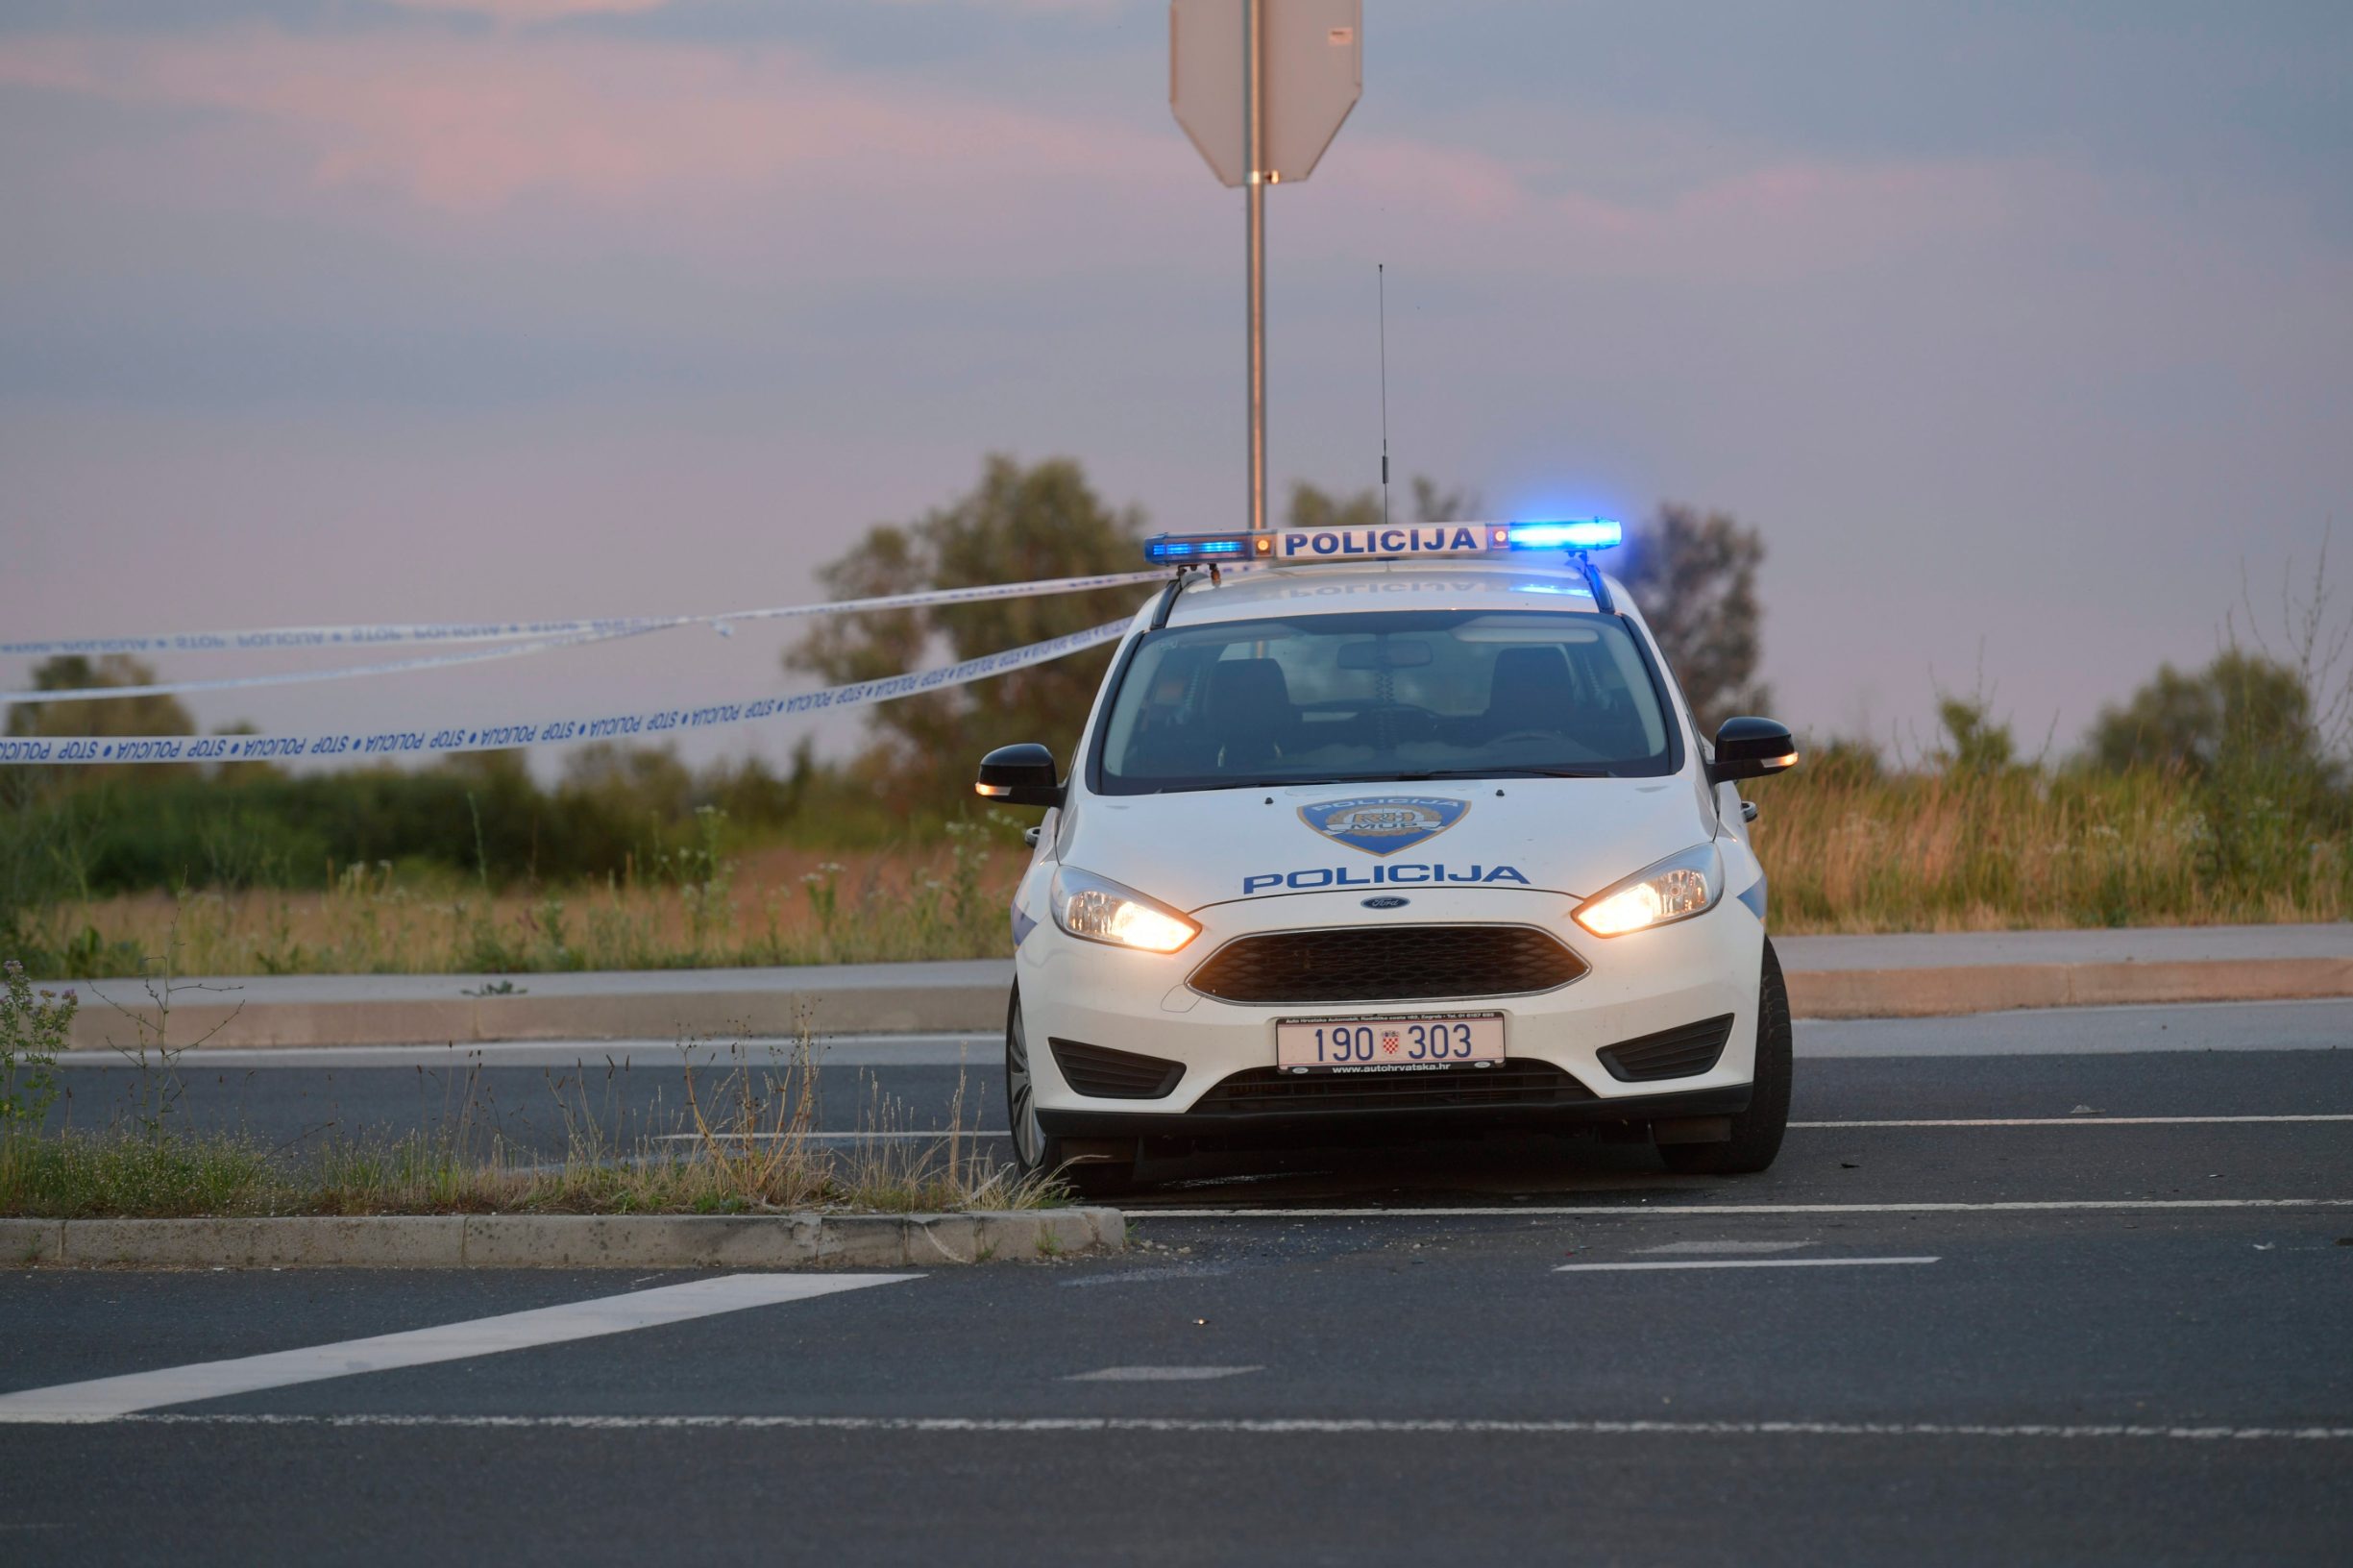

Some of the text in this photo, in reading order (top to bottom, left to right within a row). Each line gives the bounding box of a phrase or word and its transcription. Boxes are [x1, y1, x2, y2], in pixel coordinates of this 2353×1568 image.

[1286, 527, 1478, 555] POLICIJA
[786, 691, 834, 713] POLICIJA
[836, 685, 865, 704] STOP
[691, 702, 742, 725] POLICIJA
[745, 699, 774, 719] STOP
[590, 715, 643, 737] POLICIJA
[647, 711, 678, 730] STOP
[429, 729, 466, 748] STOP
[480, 724, 537, 746] POLICIJA
[541, 722, 576, 741] STOP
[58, 741, 98, 759] STOP
[116, 740, 183, 759] POLICIJA
[187, 739, 227, 757] STOP
[243, 737, 306, 756] POLICIJA
[311, 735, 349, 753] STOP
[365, 731, 425, 752] POLICIJA
[1311, 798, 1458, 812] POLICIJA
[1243, 865, 1532, 894] POLICIJA
[1315, 1023, 1472, 1062] 190 303
[1333, 1063, 1451, 1073] www.autohrvatska.hr
